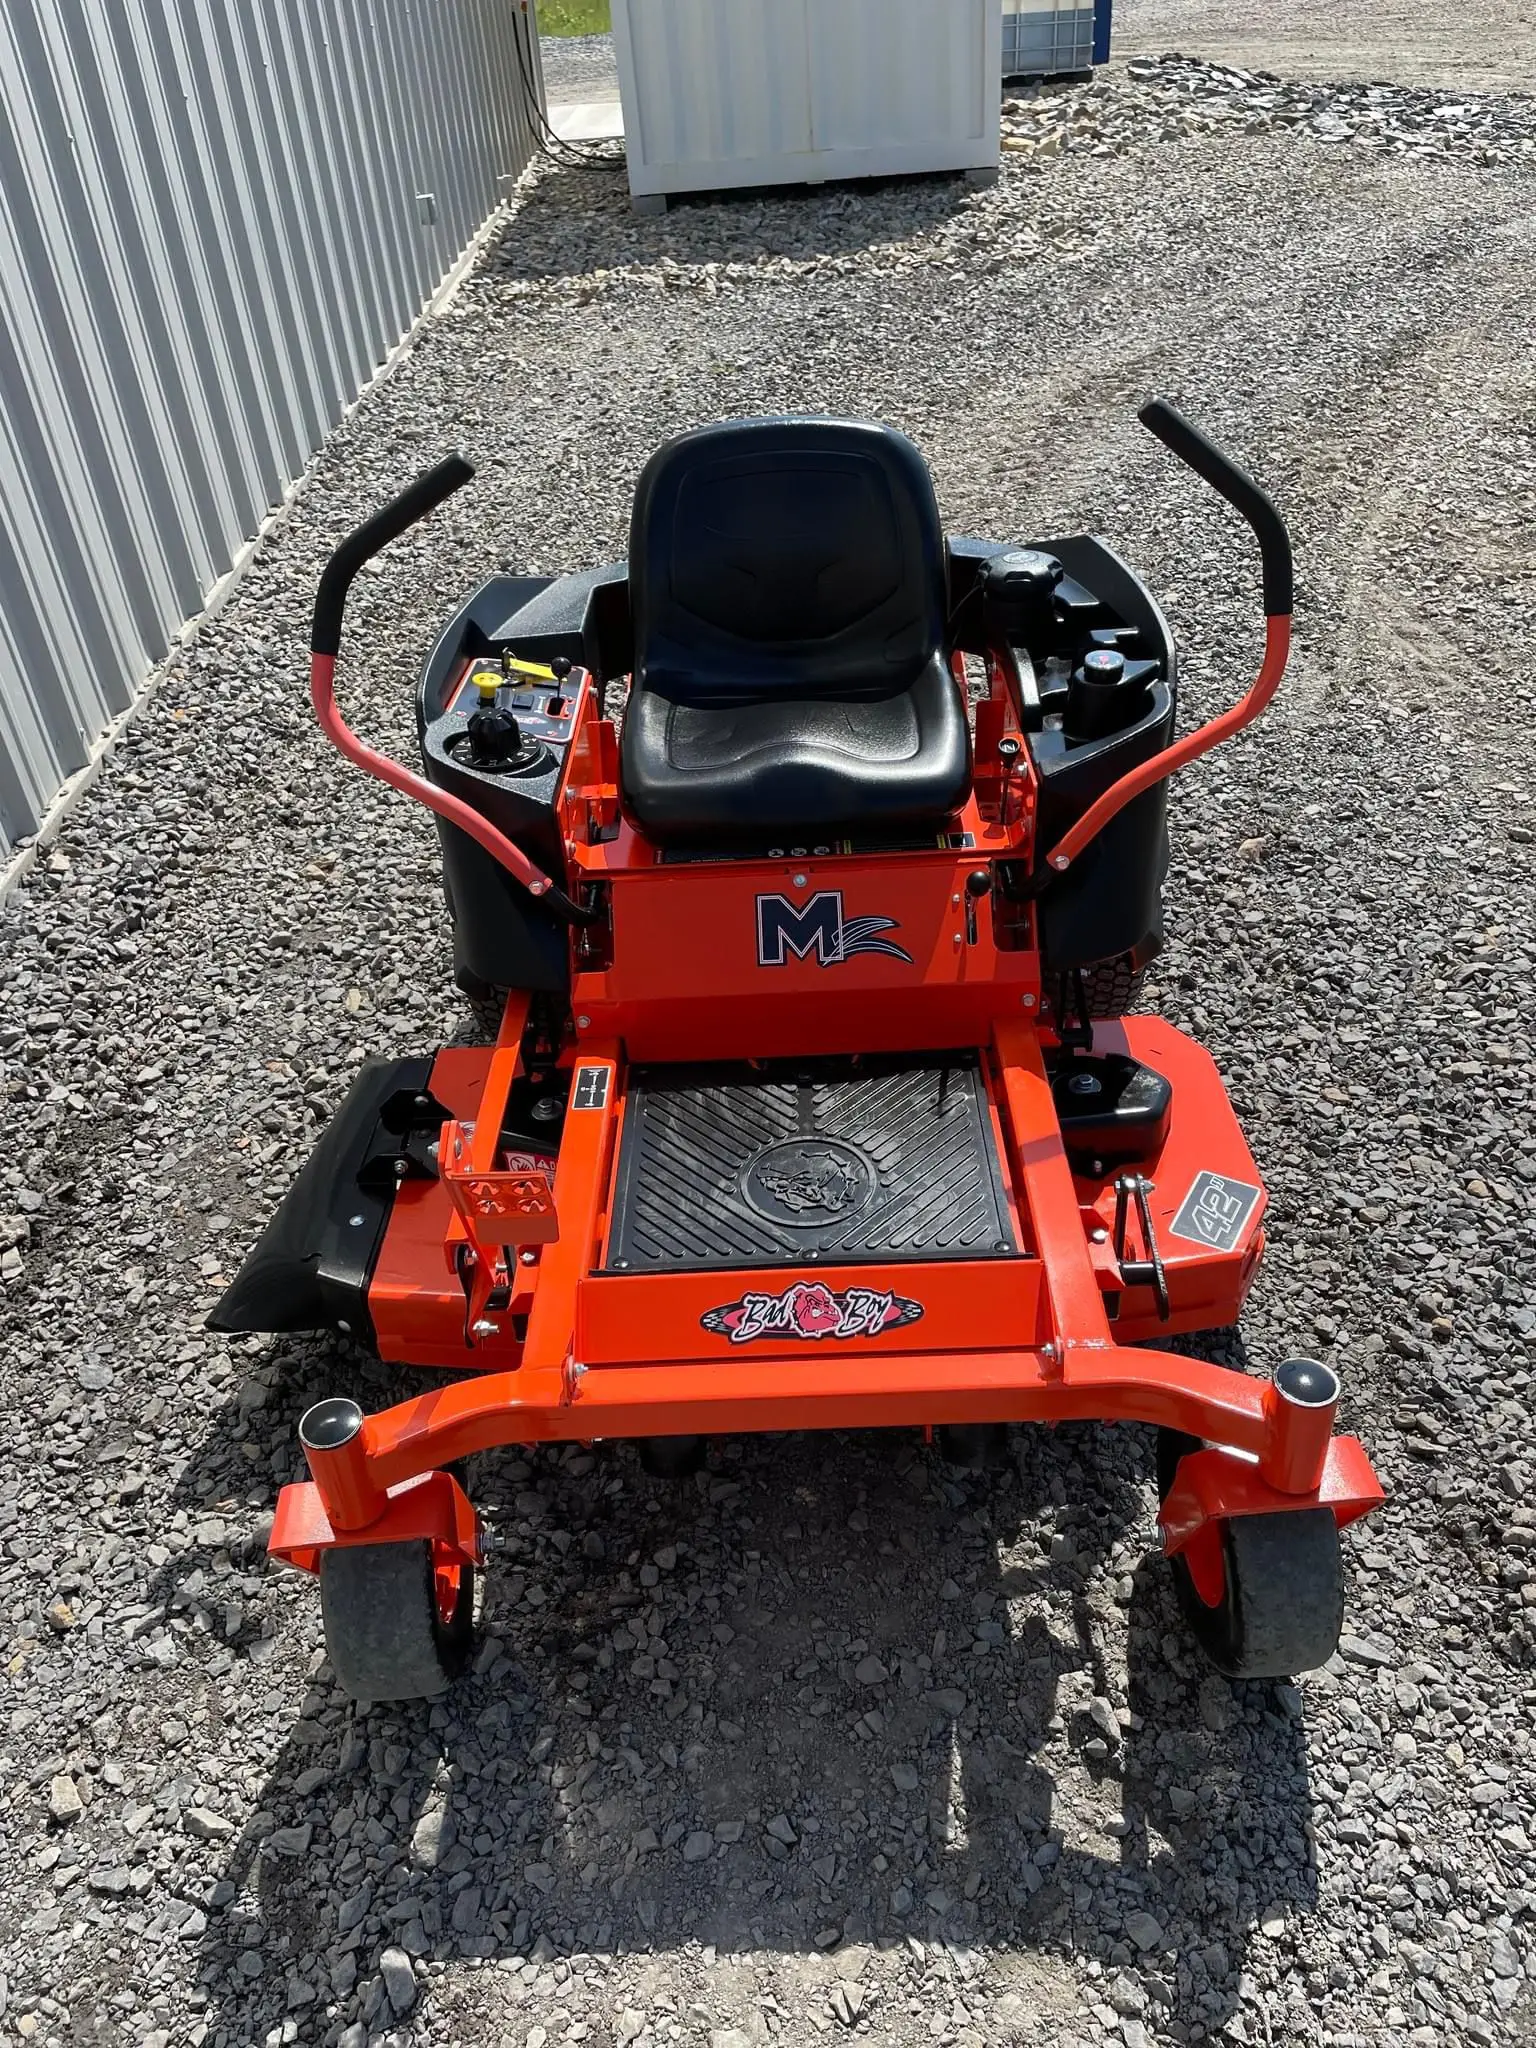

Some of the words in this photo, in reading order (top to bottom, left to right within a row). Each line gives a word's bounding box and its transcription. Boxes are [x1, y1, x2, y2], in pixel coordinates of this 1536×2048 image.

[1192, 1176, 1242, 1242] 42"
[732, 1293, 792, 1342] Bad
[837, 1292, 892, 1335] Boy
